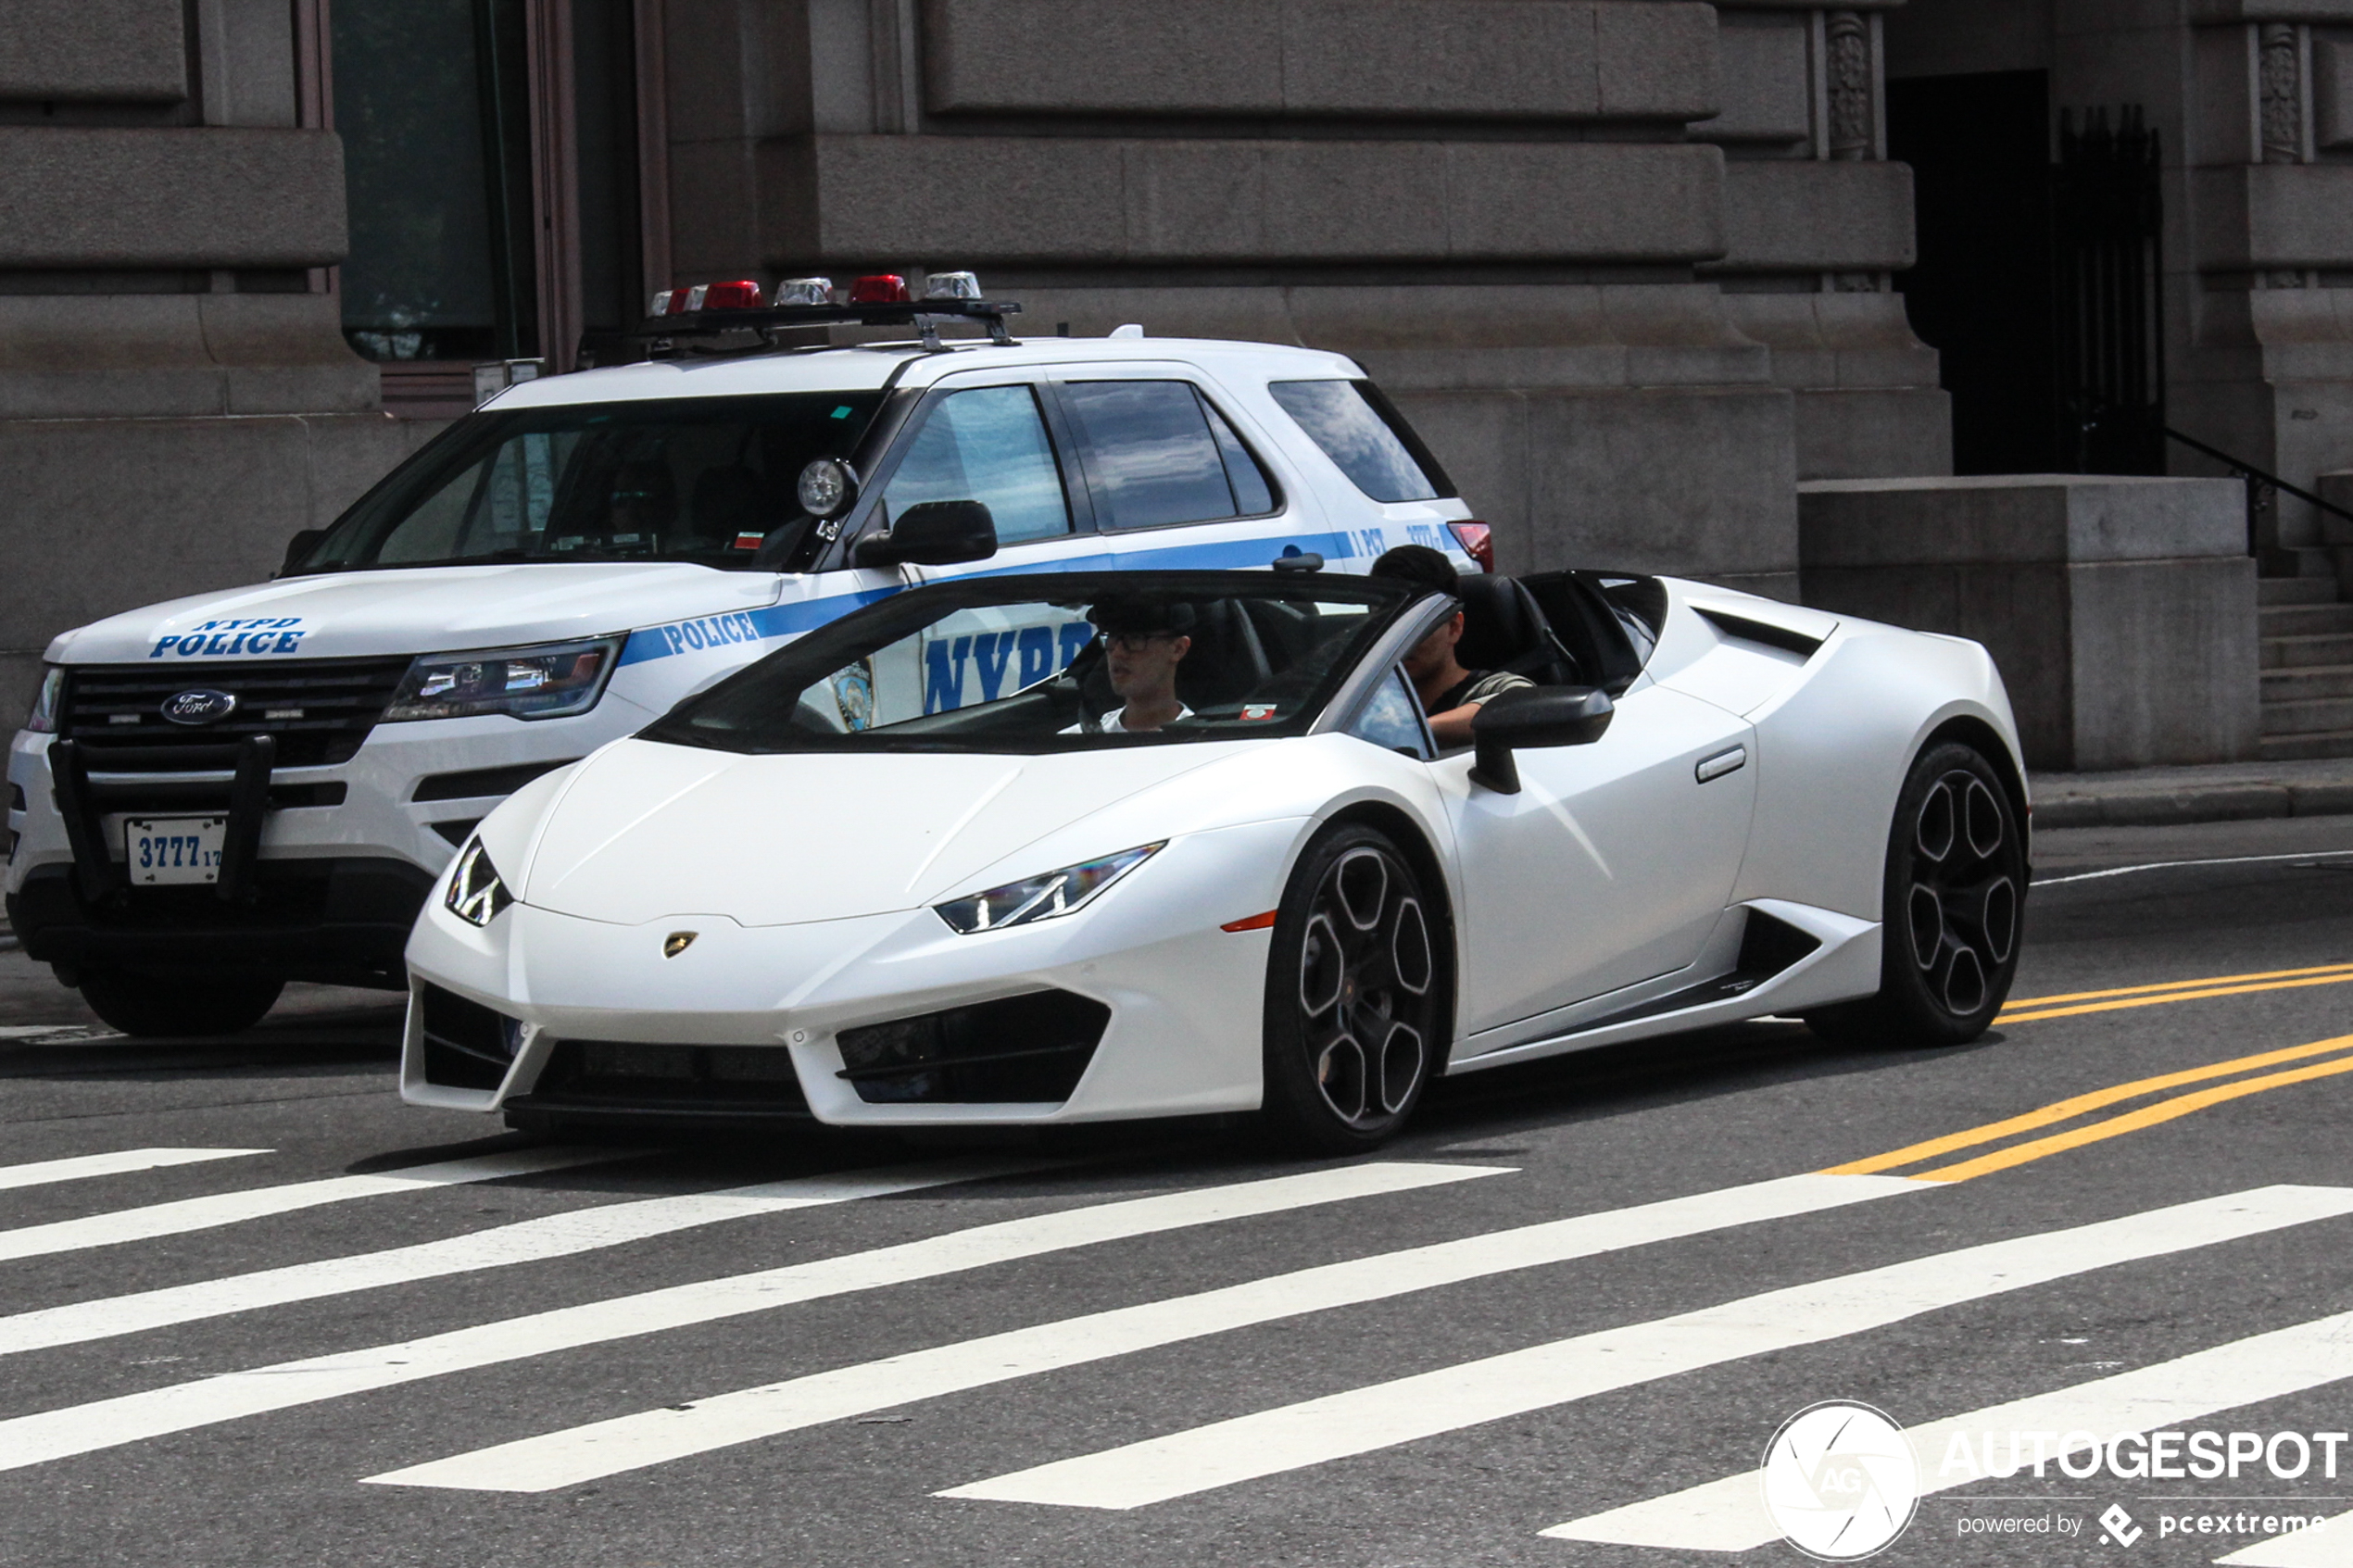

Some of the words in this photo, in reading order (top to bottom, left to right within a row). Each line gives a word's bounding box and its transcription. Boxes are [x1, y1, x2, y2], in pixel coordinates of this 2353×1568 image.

[191, 618, 303, 632] NYPD
[663, 612, 758, 655] POLICE
[149, 631, 306, 659] POLICE
[173, 693, 214, 714] Ford
[139, 835, 200, 868] 3777
[204, 850, 222, 867] 17
